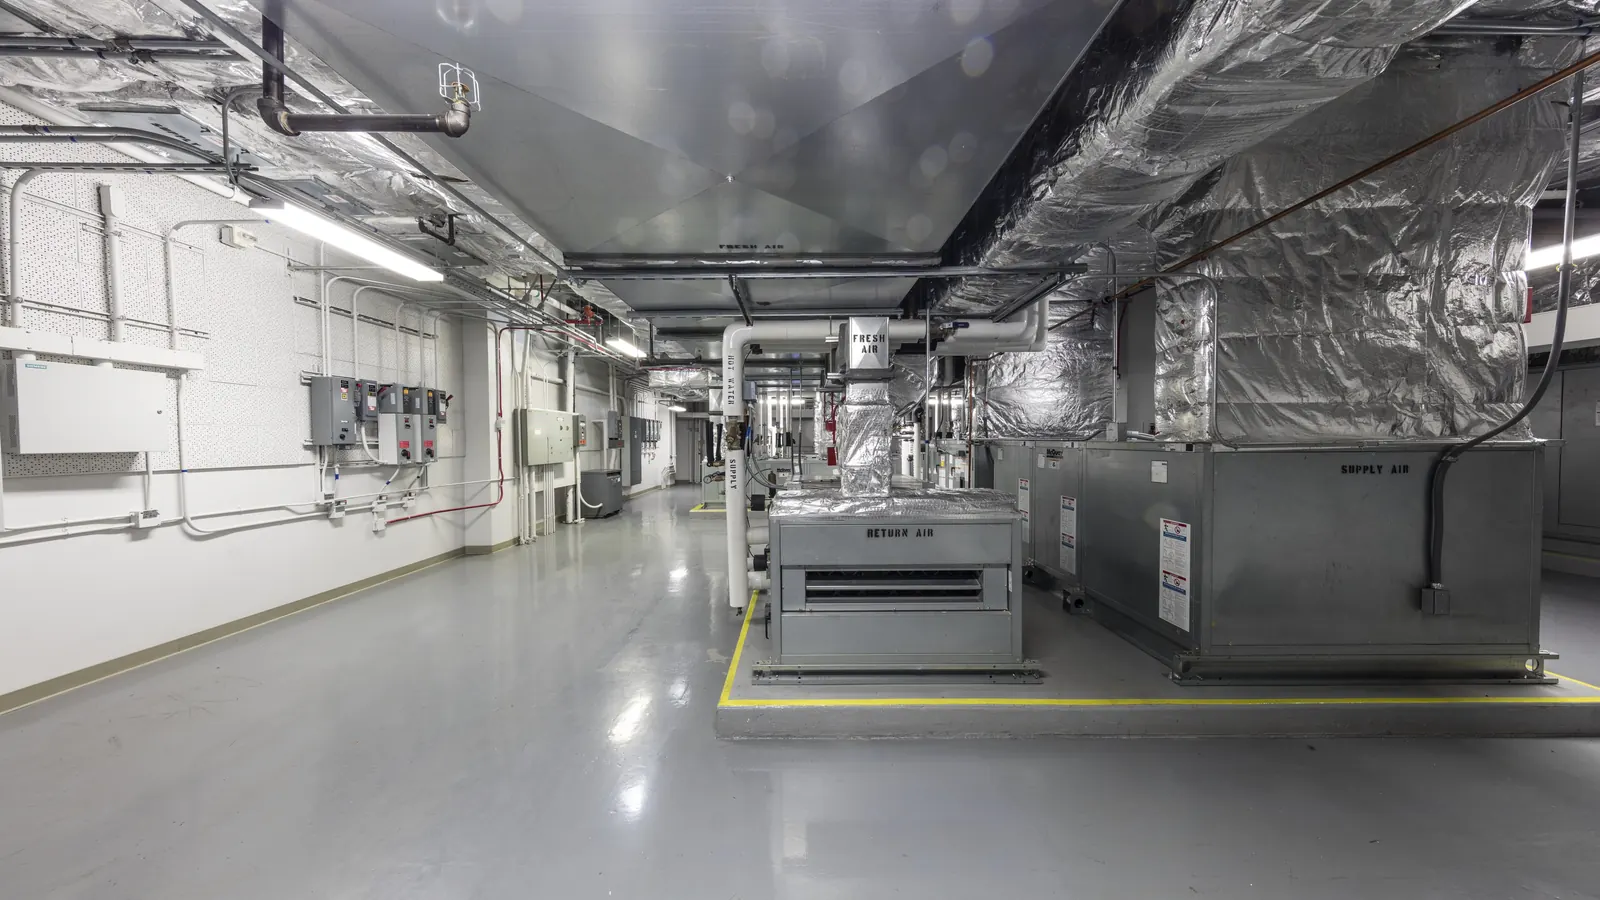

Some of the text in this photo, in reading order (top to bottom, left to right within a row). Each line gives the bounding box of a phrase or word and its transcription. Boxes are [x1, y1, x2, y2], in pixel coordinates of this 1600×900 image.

[853, 334, 885, 343] FRESH
[861, 344, 878, 354] AIR
[1341, 464, 1409, 474] SUPPLY AIR
[729, 459, 737, 490] SUPPLY
[867, 528, 934, 538] RETURN AIR
